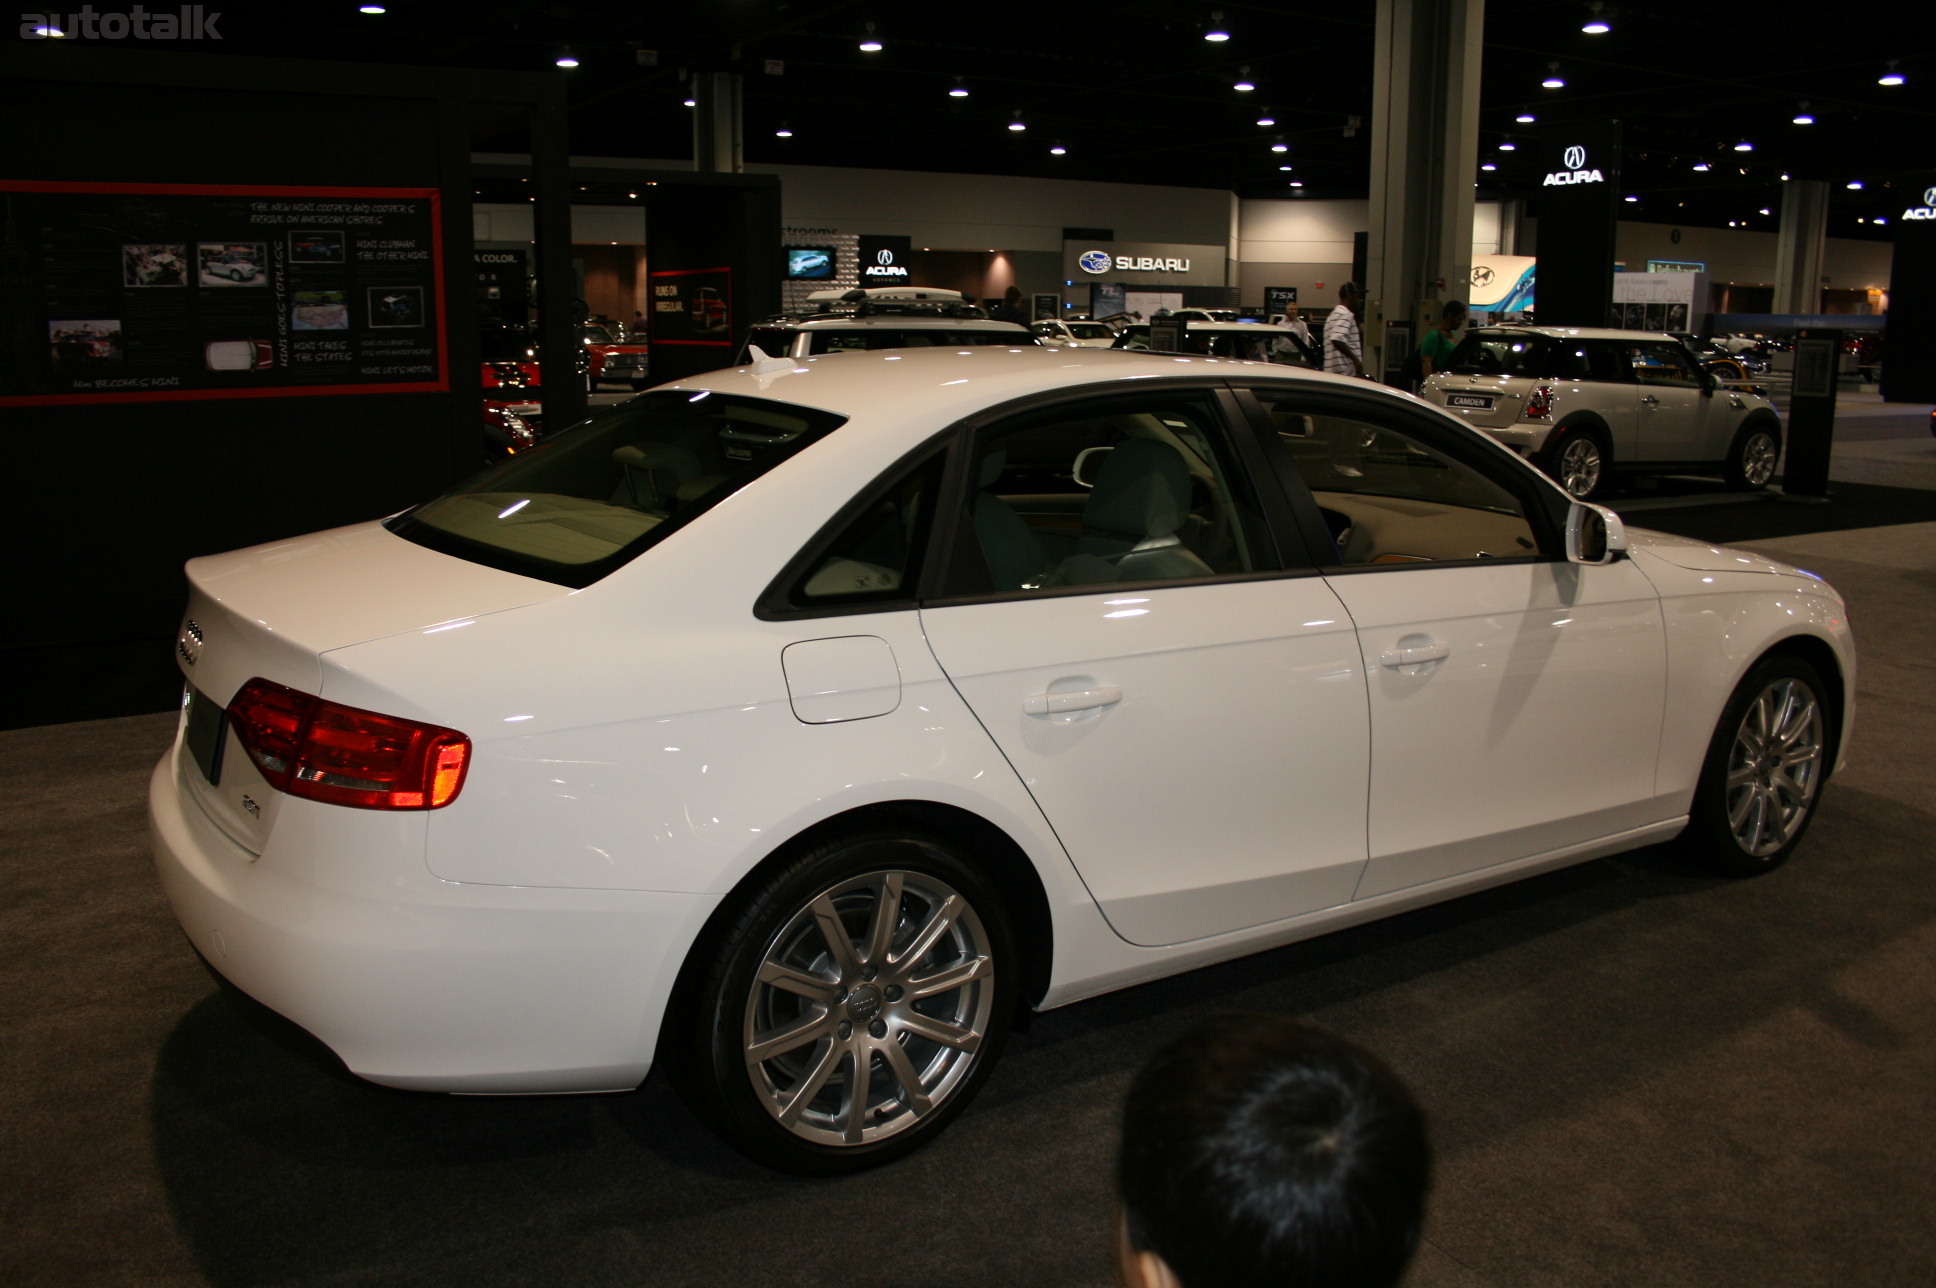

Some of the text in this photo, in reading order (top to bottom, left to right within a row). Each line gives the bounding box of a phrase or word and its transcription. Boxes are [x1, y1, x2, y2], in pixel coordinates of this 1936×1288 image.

[1543, 169, 1604, 186] ACURA
[249, 202, 269, 212] THE
[270, 203, 291, 212] NEW
[292, 203, 315, 212] MINI
[316, 203, 352, 213] COOPER
[286, 214, 300, 224] ON
[300, 214, 345, 224] AMERICAN
[482, 253, 518, 264] COLOR.
[1115, 256, 1190, 272] SUBARU
[865, 266, 908, 276] ACURA
[1271, 291, 1295, 300] TSX
[94, 378, 150, 388] BECOMES
[151, 376, 181, 386] MINI
[1453, 397, 1486, 407] CAMDEN
